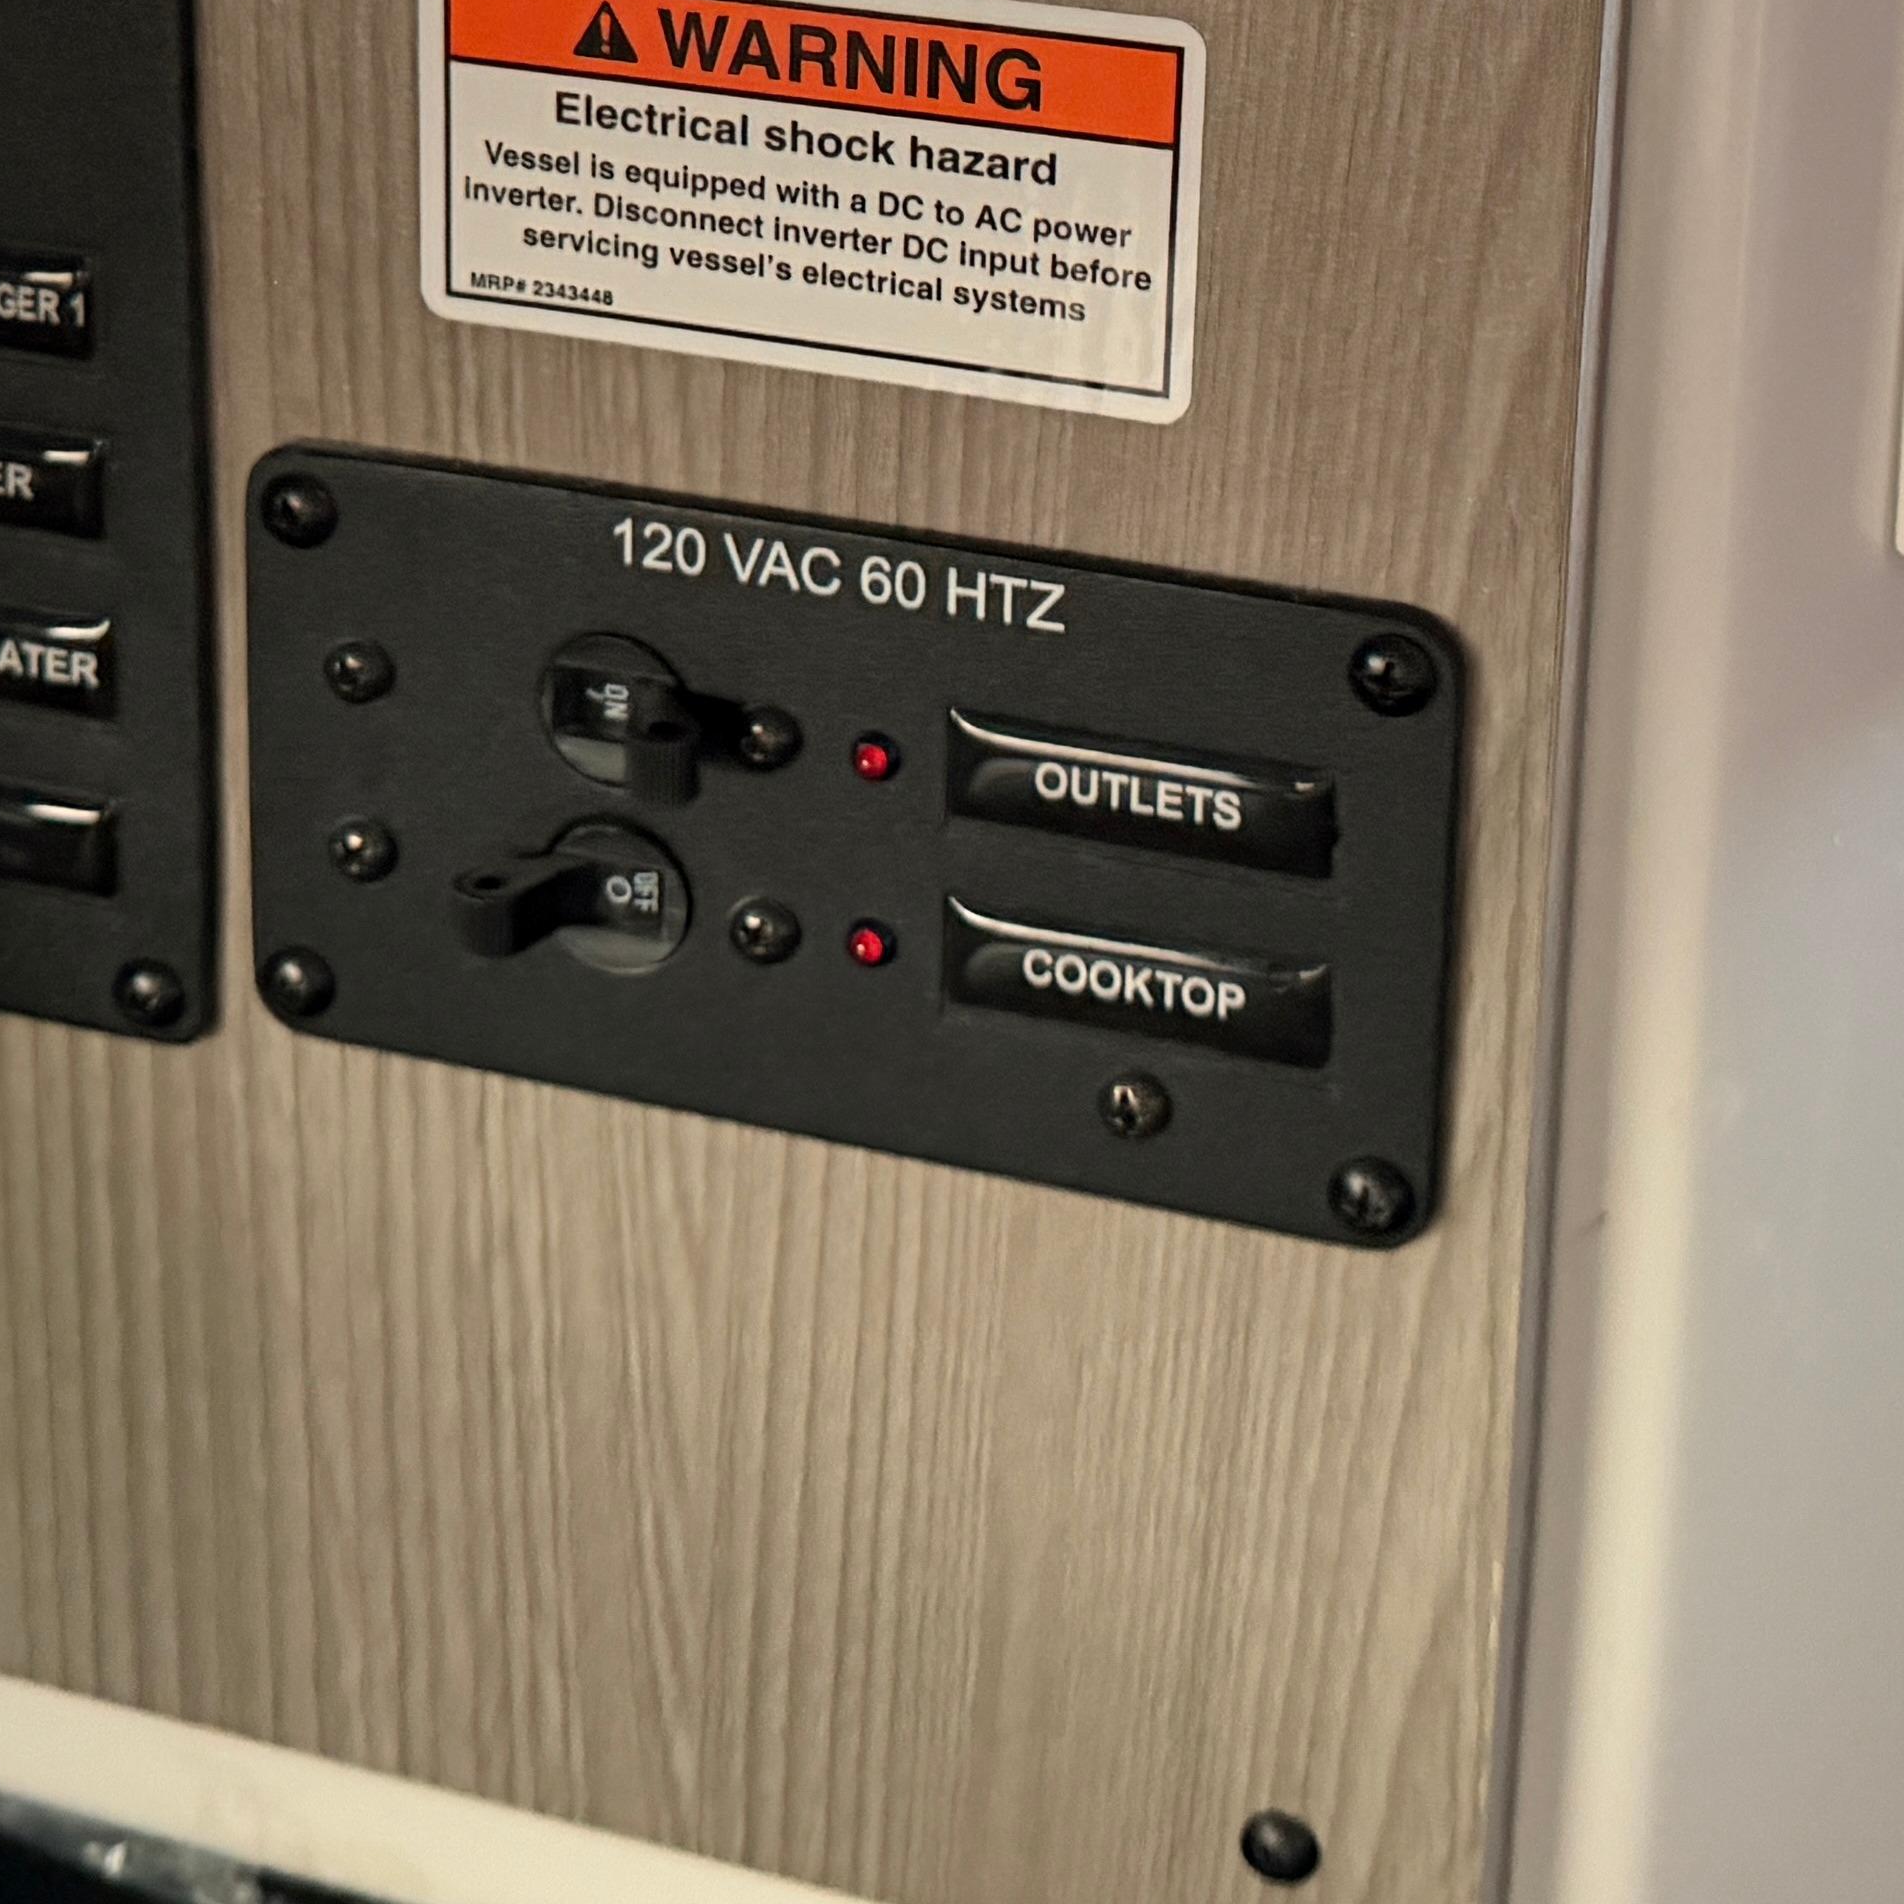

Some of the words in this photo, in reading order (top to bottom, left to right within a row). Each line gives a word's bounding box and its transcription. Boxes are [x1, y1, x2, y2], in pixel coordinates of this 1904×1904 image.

[657, 8, 1042, 112] WARNING
[556, 91, 749, 147] Electrical
[765, 120, 895, 166] shock
[910, 135, 1058, 186] hazard
[484, 140, 579, 176] Vessel
[591, 154, 615, 180] is
[625, 163, 766, 201] equipped
[776, 181, 839, 210] with
[850, 194, 867, 214] a
[879, 191, 924, 221] DC
[935, 199, 964, 227] to
[975, 204, 1022, 233] AC
[1034, 217, 1132, 247] power
[471, 272, 526, 293] MRP#
[533, 280, 613, 305] 2343448
[523, 226, 659, 269] servicing
[669, 247, 792, 282] vessel's
[802, 262, 942, 302] electrical
[953, 284, 1086, 322] systems
[595, 193, 764, 239] Disconnect
[774, 216, 892, 255] inverter
[903, 234, 949, 263] DC
[959, 241, 1039, 276] input
[1051, 254, 1152, 291] before
[69, 292, 85, 327] 1
[612, 516, 706, 576] 120
[723, 532, 842, 596] VAC
[859, 555, 927, 610] 60
[946, 567, 1065, 634] HTZ
[604, 682, 629, 721] ON
[1035, 762, 1242, 830] OUTLETS
[1023, 948, 1245, 1021] COOKTOP
